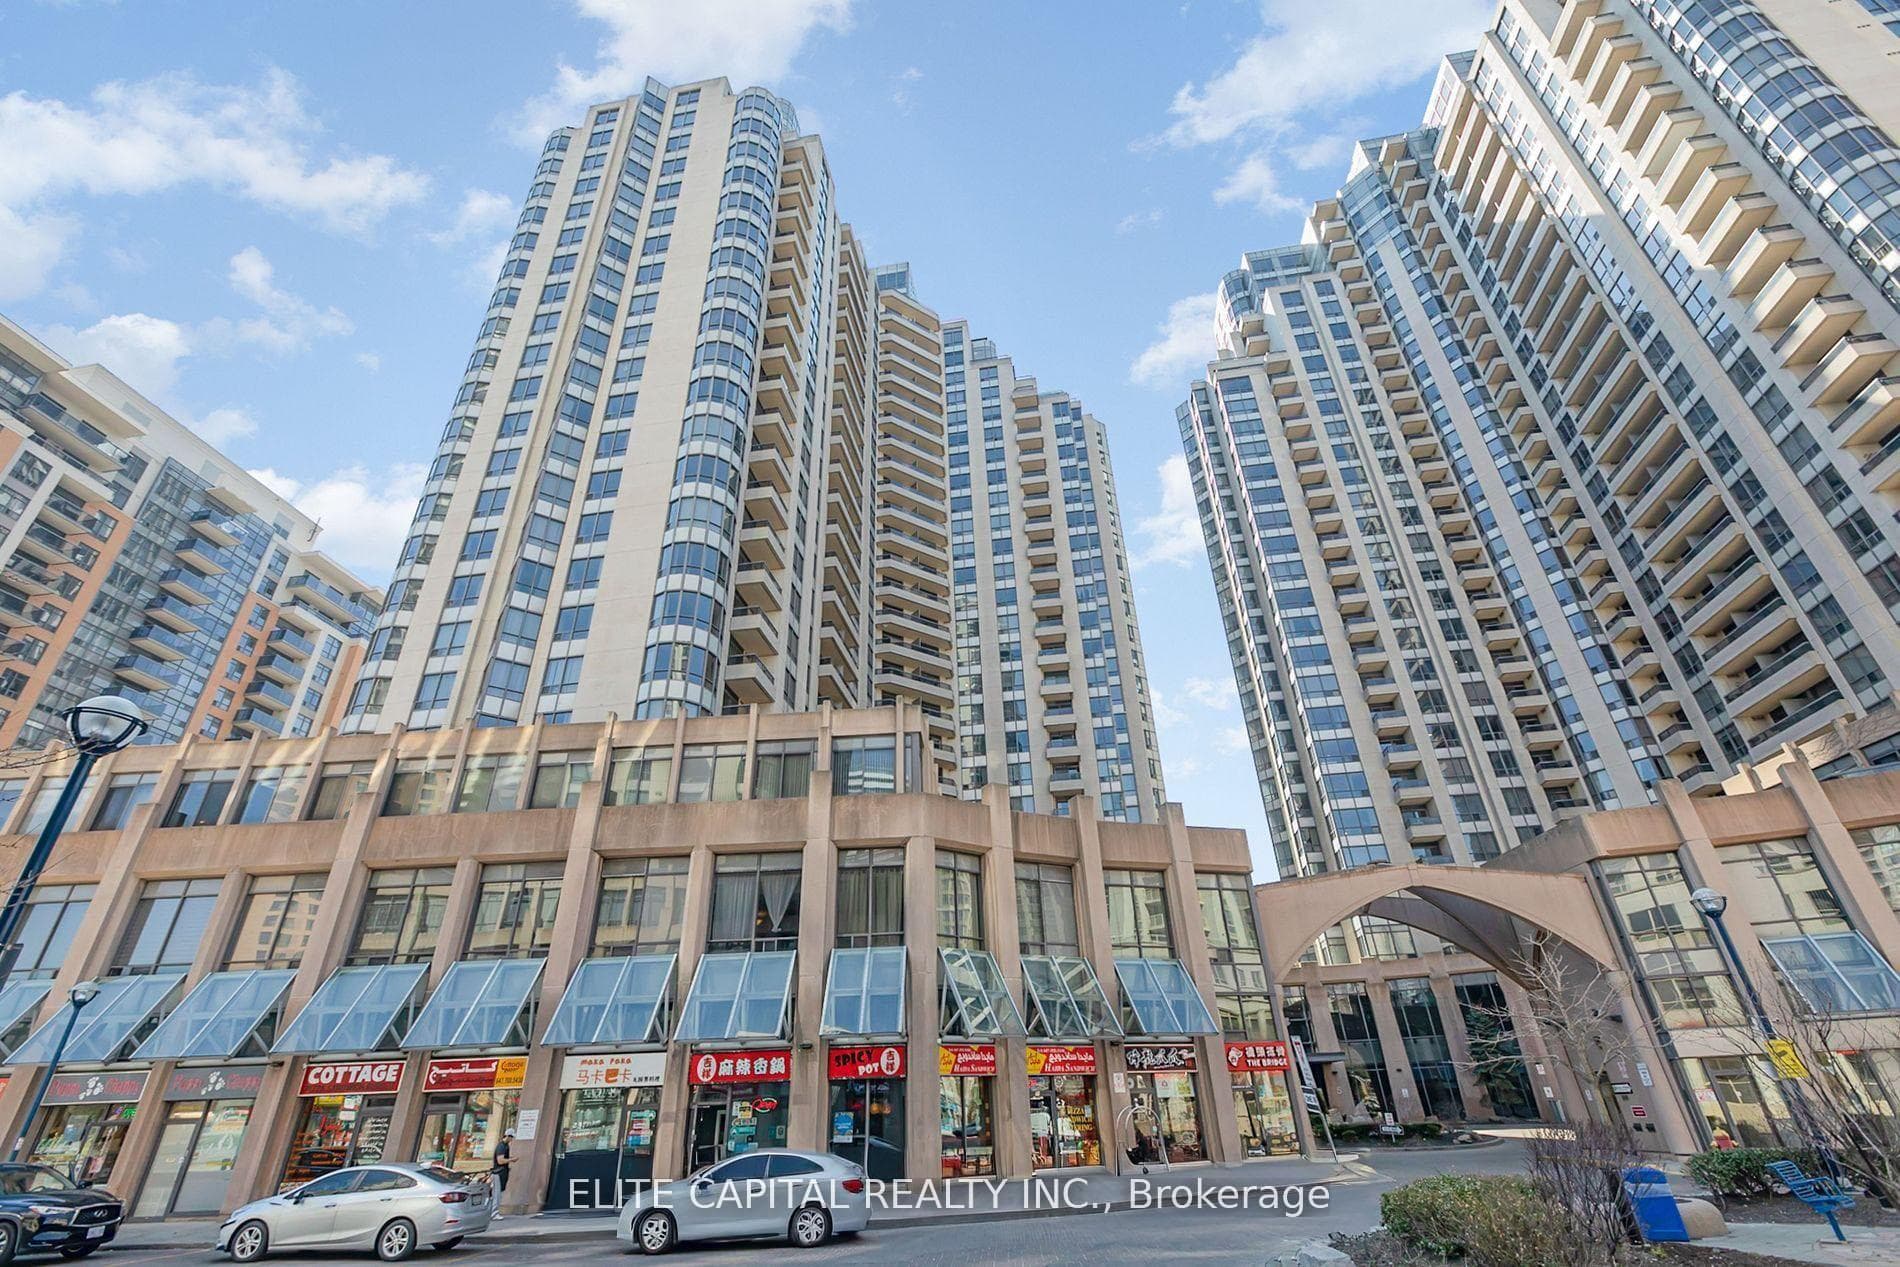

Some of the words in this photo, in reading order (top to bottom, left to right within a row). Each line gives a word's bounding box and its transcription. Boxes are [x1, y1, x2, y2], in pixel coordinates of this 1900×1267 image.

[835, 1049, 873, 1067] SPICY
[1246, 1059, 1261, 1067] THE
[1262, 1058, 1288, 1067] BRIDGE
[308, 1064, 400, 1084] COTTAGE
[576, 1067, 632, 1085] 马卡巴卡
[858, 1062, 880, 1076] POT
